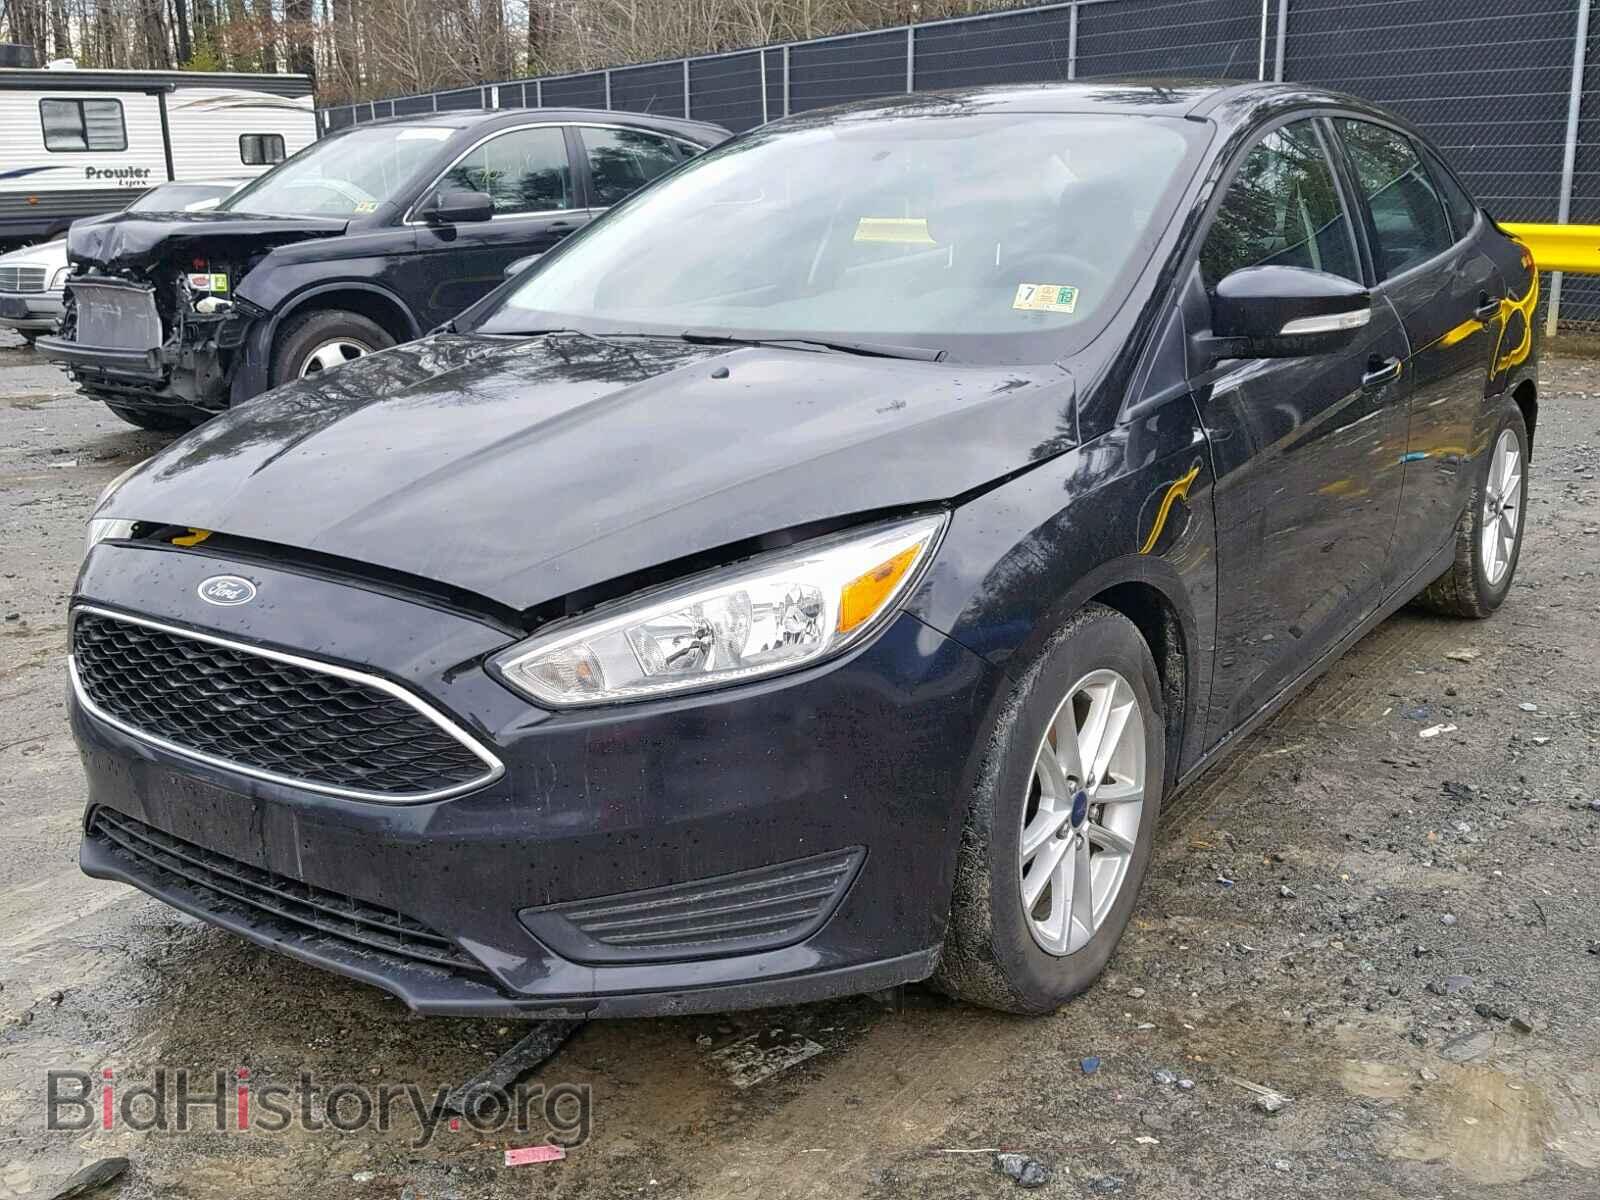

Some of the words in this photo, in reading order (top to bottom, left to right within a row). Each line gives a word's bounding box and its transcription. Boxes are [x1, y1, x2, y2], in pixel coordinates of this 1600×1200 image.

[85, 166, 151, 179] Prowler
[1025, 286, 1036, 301] 7
[207, 581, 244, 600] Ford
